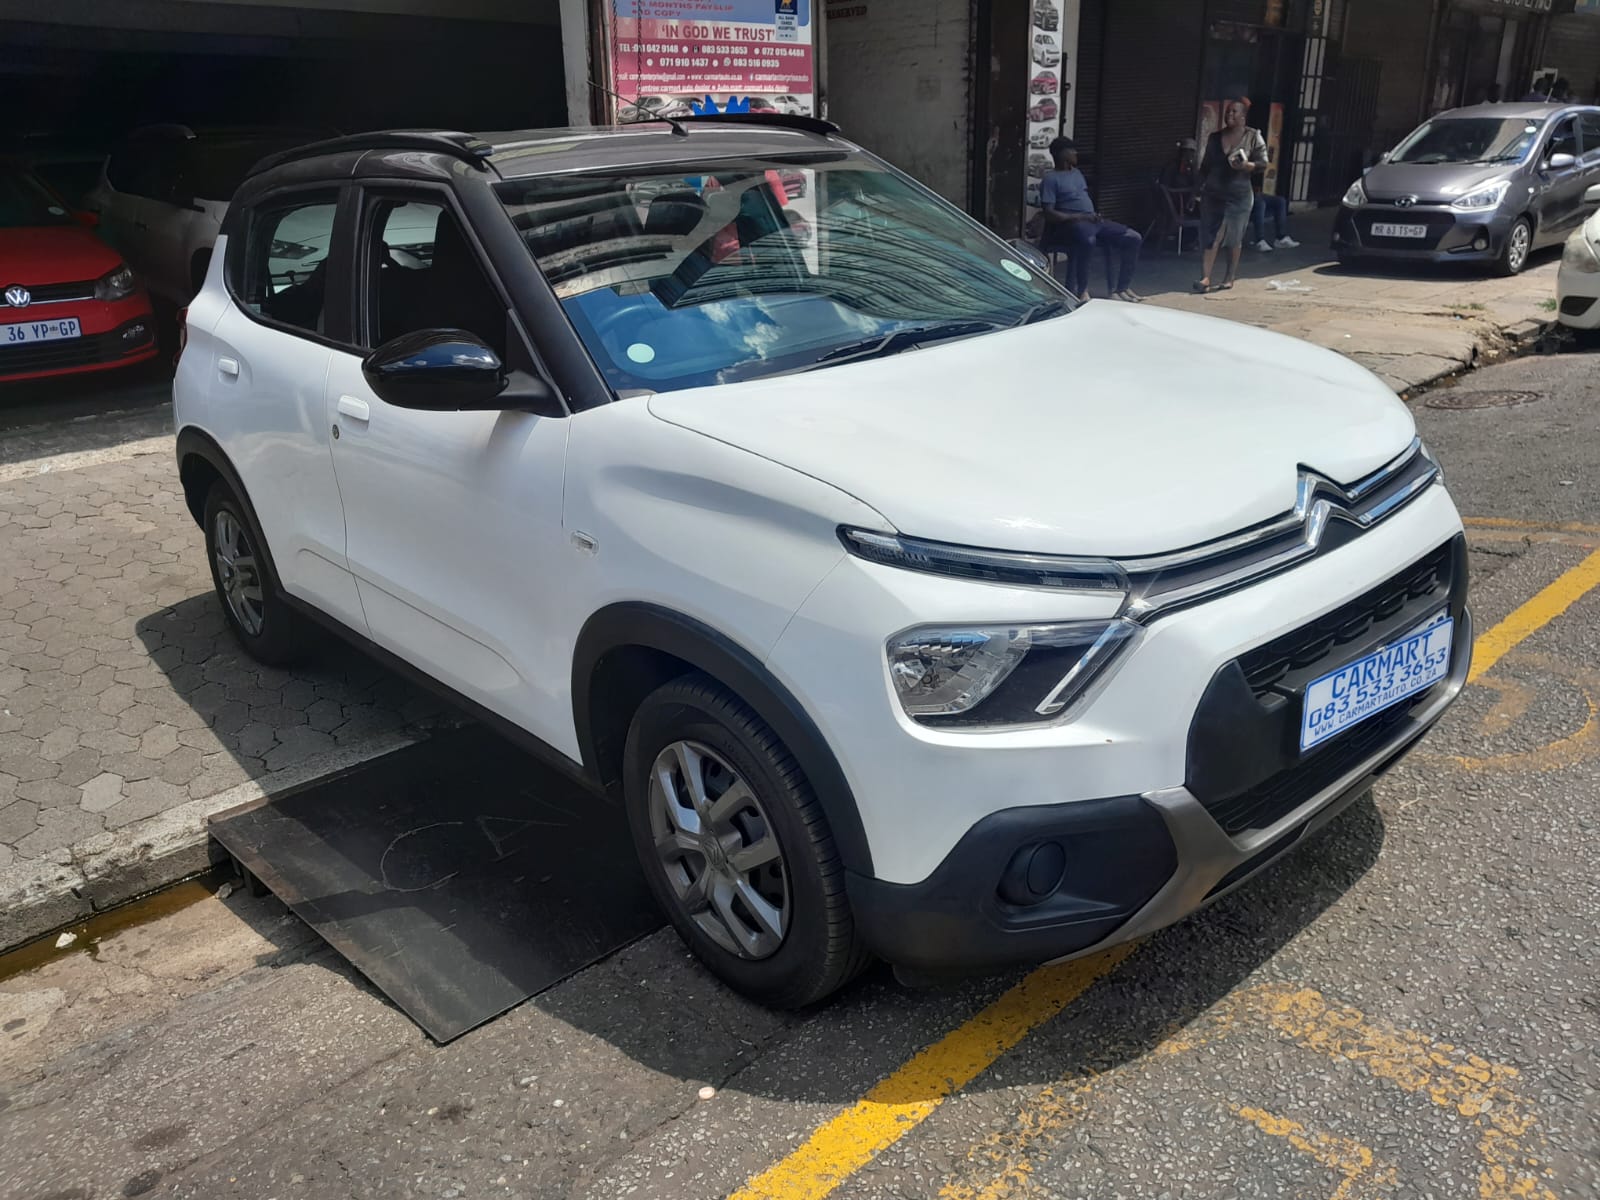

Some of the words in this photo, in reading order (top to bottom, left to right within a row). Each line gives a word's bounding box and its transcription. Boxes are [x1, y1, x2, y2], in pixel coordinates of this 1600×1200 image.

[649, 1, 693, 10] MONTHS
[683, 25, 709, 39] GOD
[712, 26, 731, 40] WE
[8, 326, 25, 342] 36
[32, 323, 48, 338] YP
[60, 322, 76, 336] GP
[1332, 632, 1433, 698] CARMART
[1308, 694, 1350, 729] 083
[1356, 673, 1394, 704] 533
[1400, 646, 1446, 682] 3653
